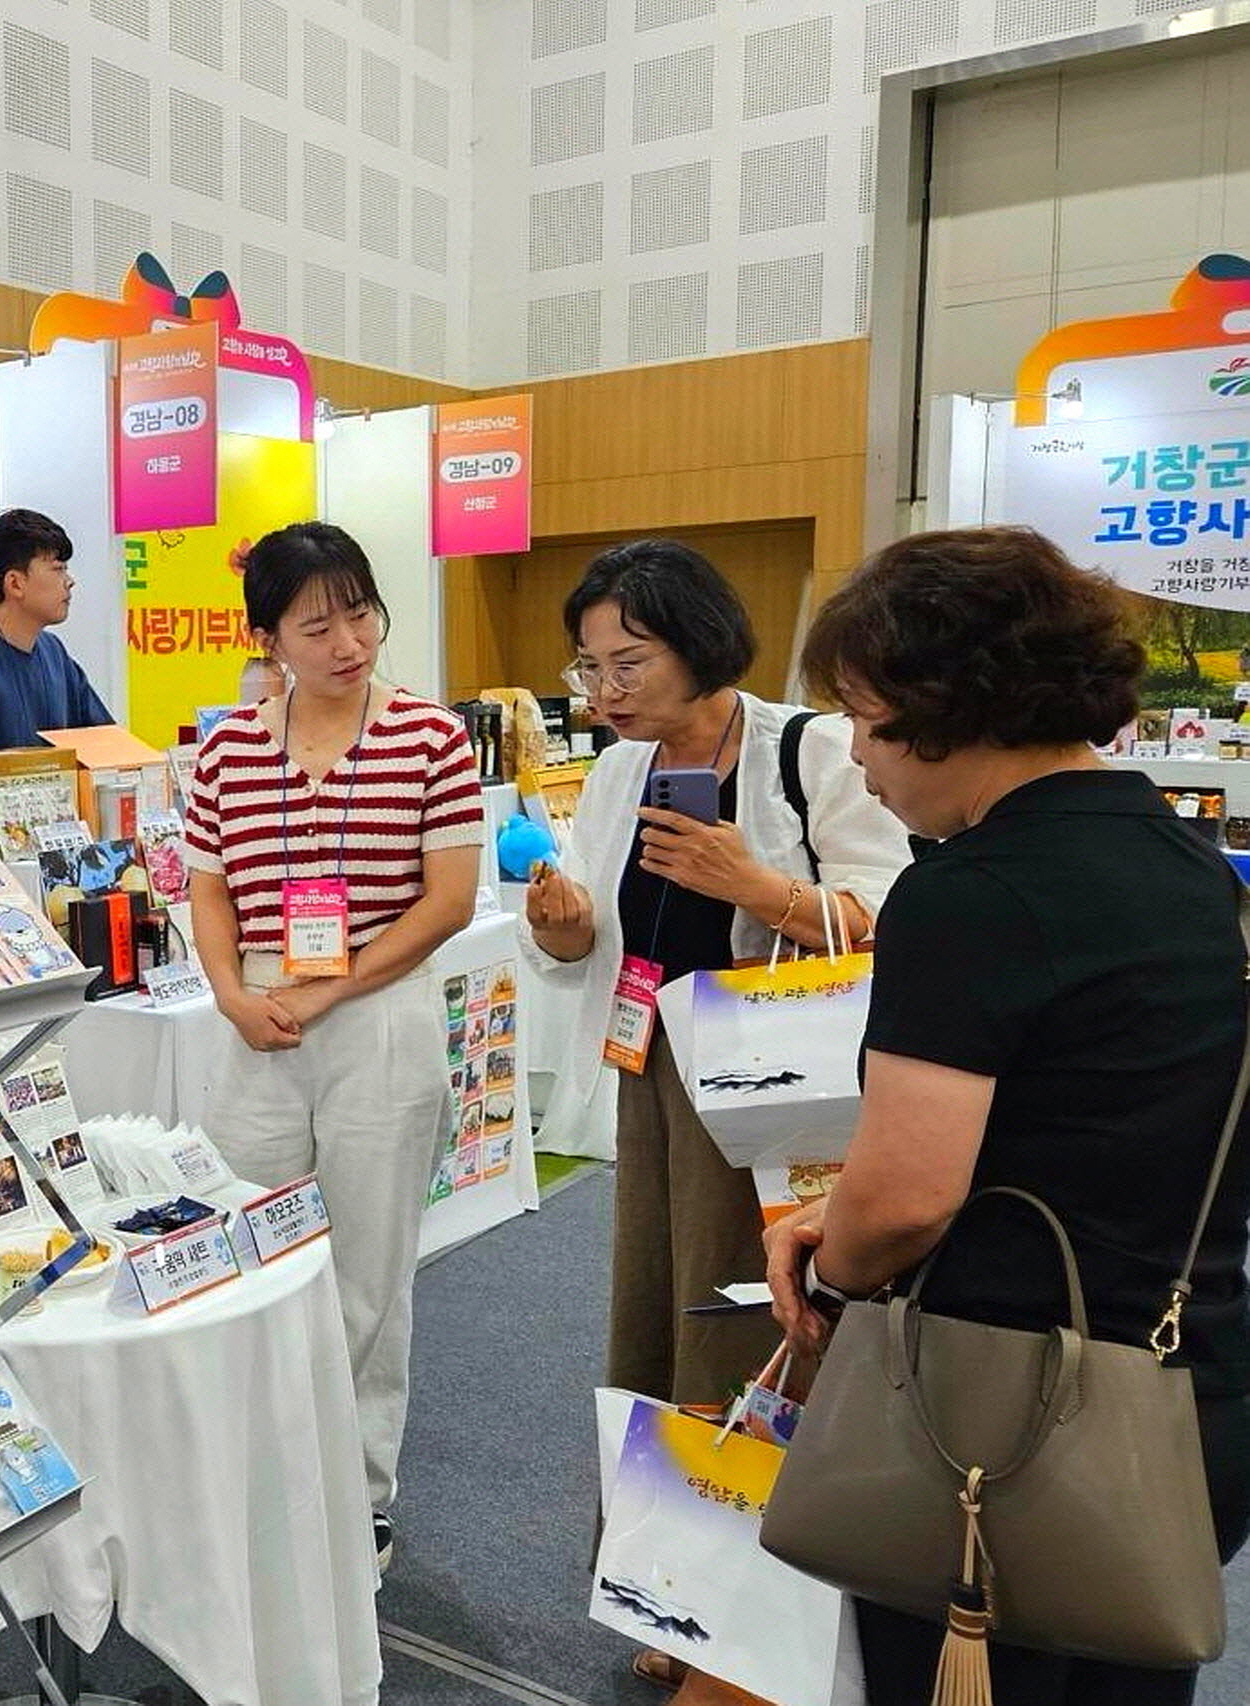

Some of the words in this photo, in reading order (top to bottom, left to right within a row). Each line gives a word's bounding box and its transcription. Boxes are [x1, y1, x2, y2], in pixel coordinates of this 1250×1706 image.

[130, 403, 199, 433] 경남-08
[146, 455, 182, 474] 하동군
[449, 456, 514, 479] 경남-09
[1101, 438, 1250, 492] 거창군
[1094, 498, 1250, 547] 고향사
